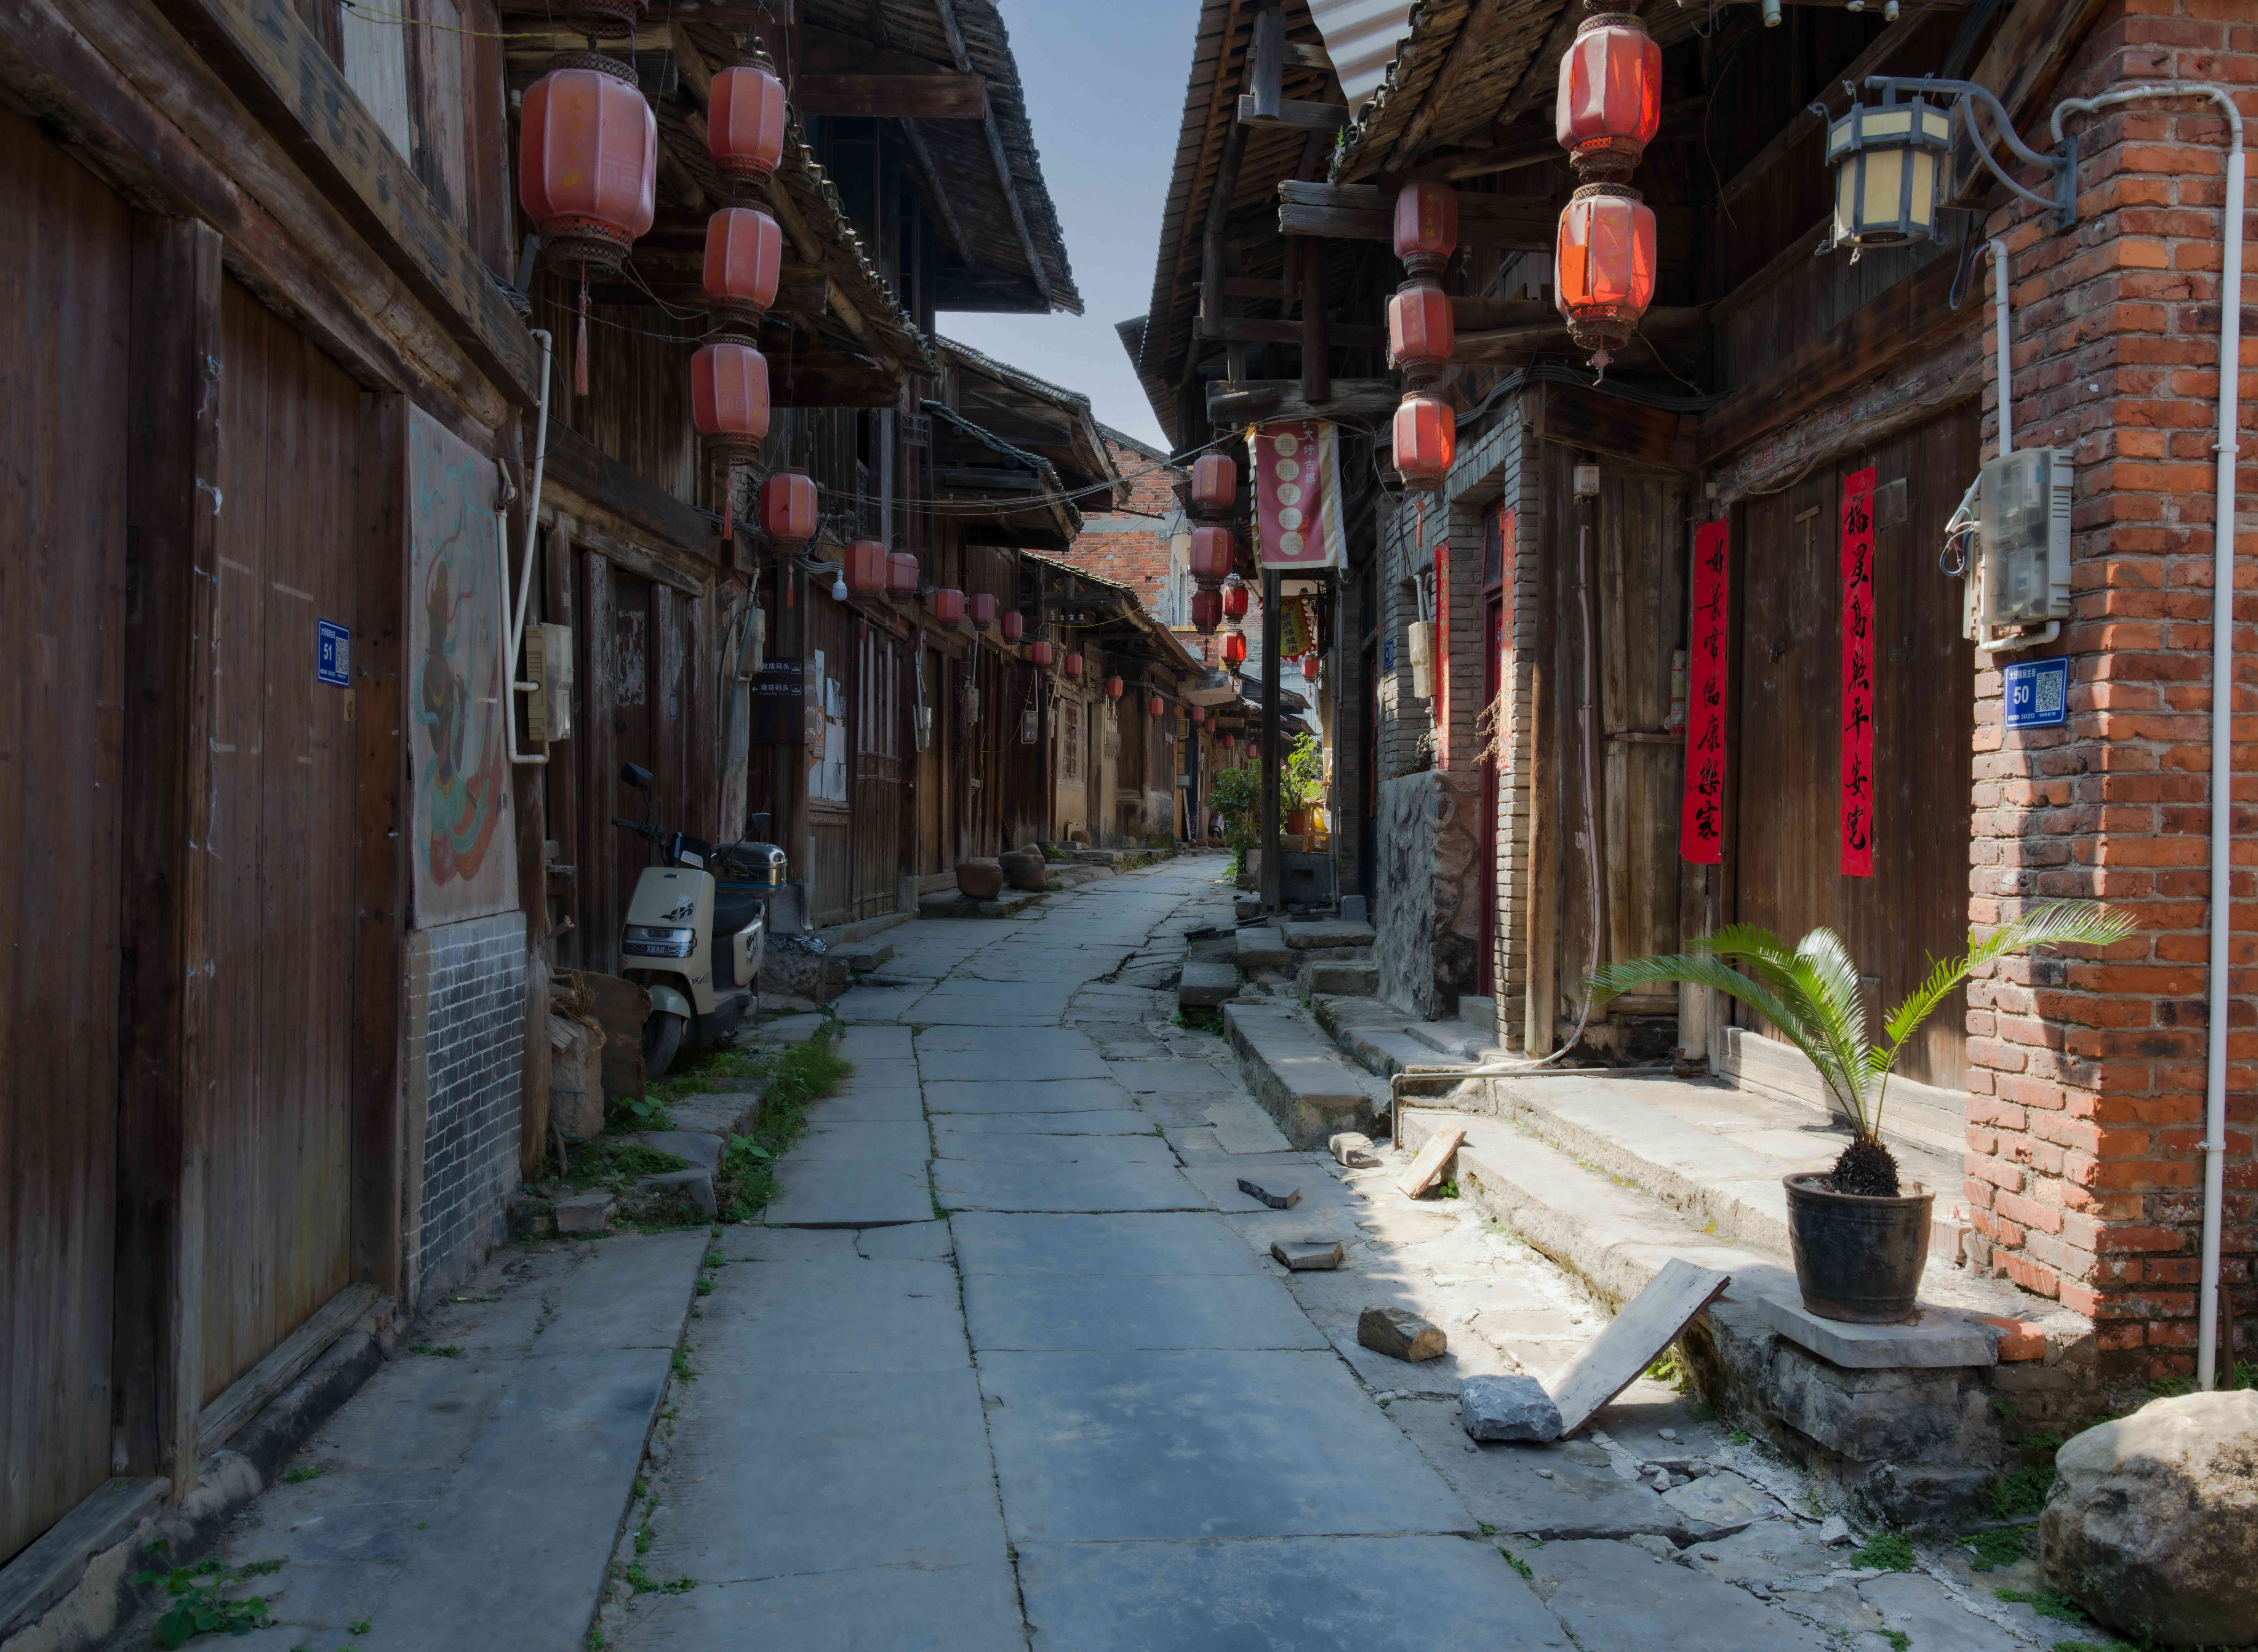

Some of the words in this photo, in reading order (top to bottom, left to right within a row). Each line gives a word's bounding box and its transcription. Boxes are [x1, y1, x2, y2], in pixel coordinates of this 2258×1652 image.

[1303, 428, 1317, 484] 大圩古镇
[1277, 437, 1300, 552] 鱼腥草油茶
[1280, 612, 1298, 654] 颈肩腰腿痛
[324, 643, 332, 661] 51
[2009, 668, 2037, 681] 大圩镇民主街
[2013, 685, 2029, 705] 50
[646, 945, 665, 954] XDAO
